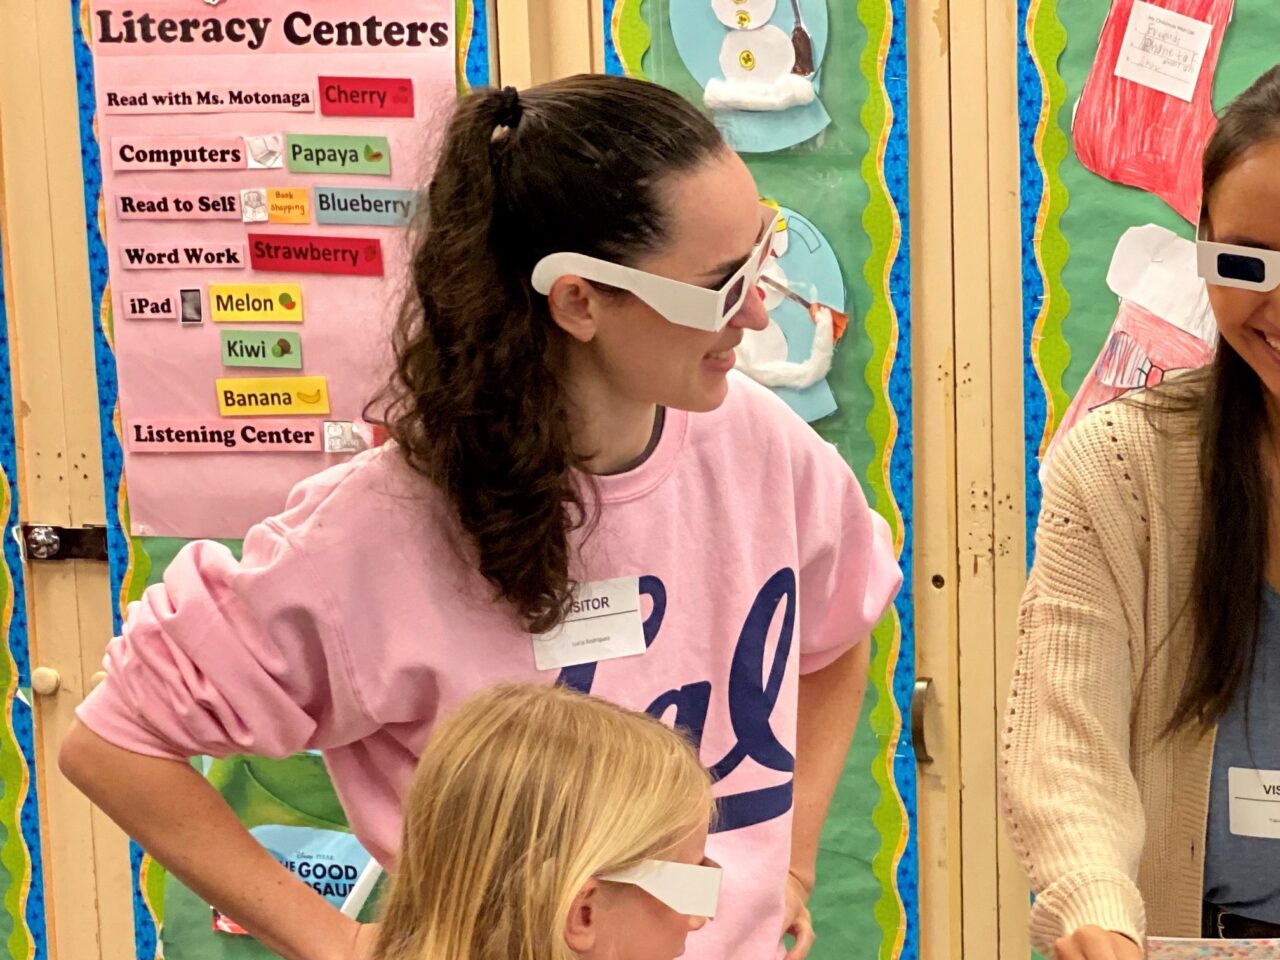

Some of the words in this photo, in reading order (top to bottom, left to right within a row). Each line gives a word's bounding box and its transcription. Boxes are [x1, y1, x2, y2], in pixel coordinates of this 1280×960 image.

[96, 9, 272, 50] Literacy
[283, 11, 449, 47] Centers
[107, 92, 148, 106] Read
[152, 91, 193, 106] with
[197, 91, 225, 106] Ms.
[228, 90, 311, 109] Motonaga
[324, 84, 387, 108] Cherry
[119, 145, 242, 167] Computers
[292, 144, 359, 169] Papaya
[121, 196, 170, 212] Read
[174, 196, 194, 212] to
[198, 195, 237, 212] Self
[318, 193, 412, 221] Blueberry
[125, 248, 179, 264] Word
[184, 248, 240, 264] Work
[254, 240, 359, 266] Strawberry
[130, 298, 173, 314] iPad
[216, 293, 274, 313] Melon
[227, 338, 267, 359] Kiwi
[224, 389, 292, 408] Banana
[134, 425, 236, 447] Listening
[241, 426, 315, 444] Center
[298, 862, 357, 880] GOOD
